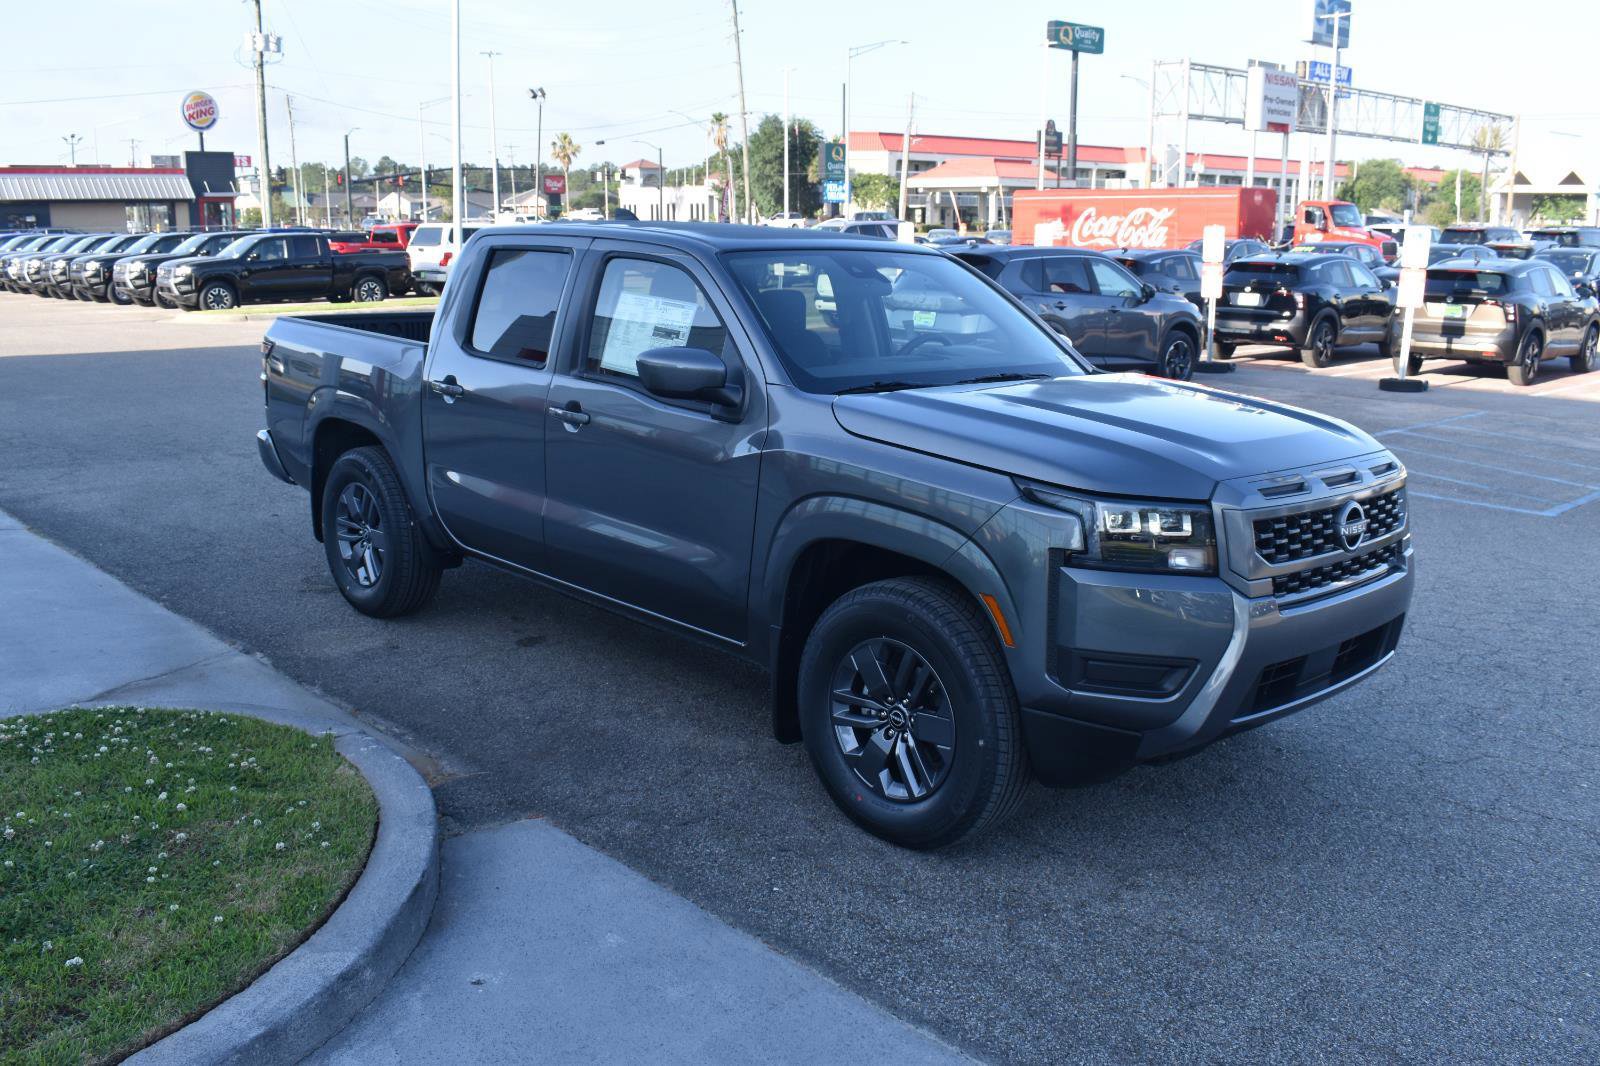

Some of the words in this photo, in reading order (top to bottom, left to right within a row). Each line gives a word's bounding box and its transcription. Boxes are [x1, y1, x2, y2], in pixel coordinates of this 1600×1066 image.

[1074, 26, 1100, 42] Quality
[1315, 63, 1330, 77] ALL
[1265, 73, 1297, 88] NISSAN
[186, 99, 213, 112] BURGER
[1264, 95, 1296, 107] Pre-Owned
[188, 106, 215, 121] KING
[1267, 107, 1291, 117] Vehicles
